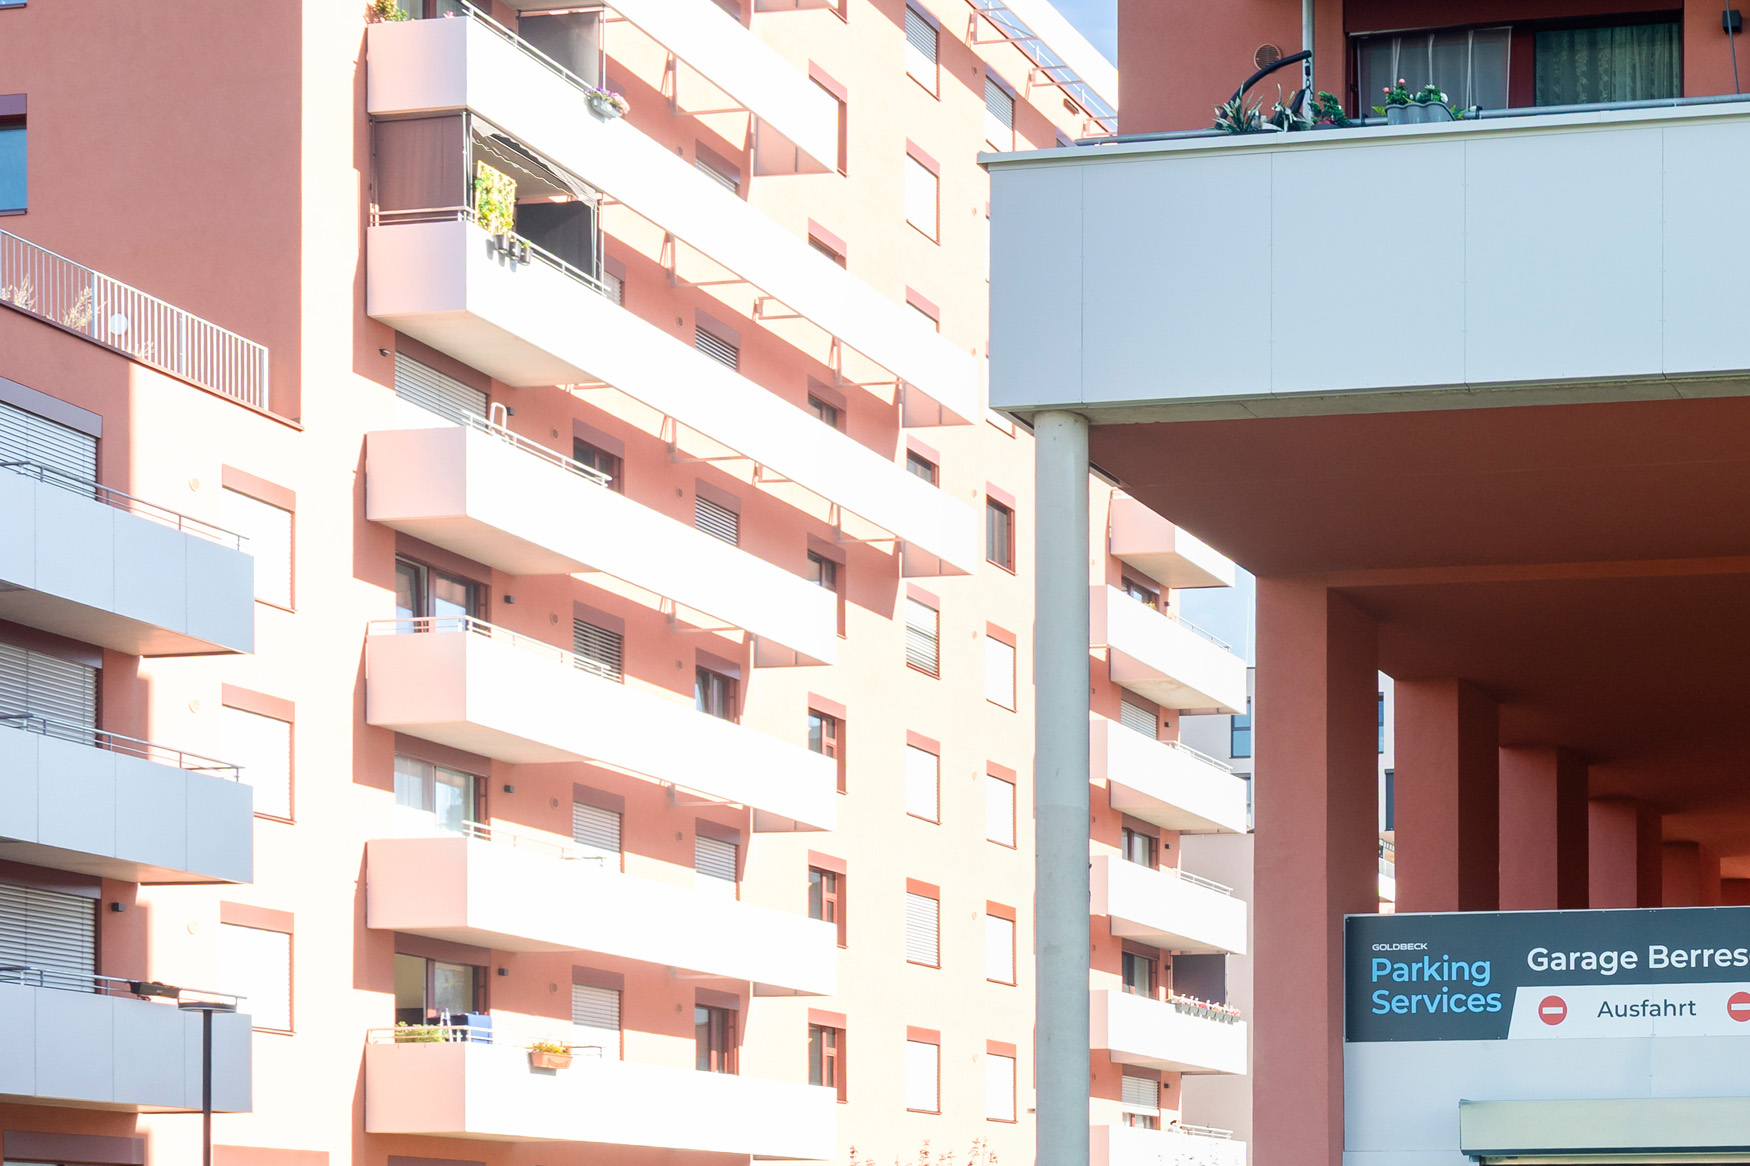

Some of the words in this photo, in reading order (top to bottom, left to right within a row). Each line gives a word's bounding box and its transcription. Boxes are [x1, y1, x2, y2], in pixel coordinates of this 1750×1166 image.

[1371, 942, 1428, 951] GOLDBECK
[1371, 953, 1491, 987] Parking
[1526, 947, 1639, 976] Garage
[1371, 986, 1502, 1015] Services
[1597, 999, 1697, 1019] Ausfahrt
